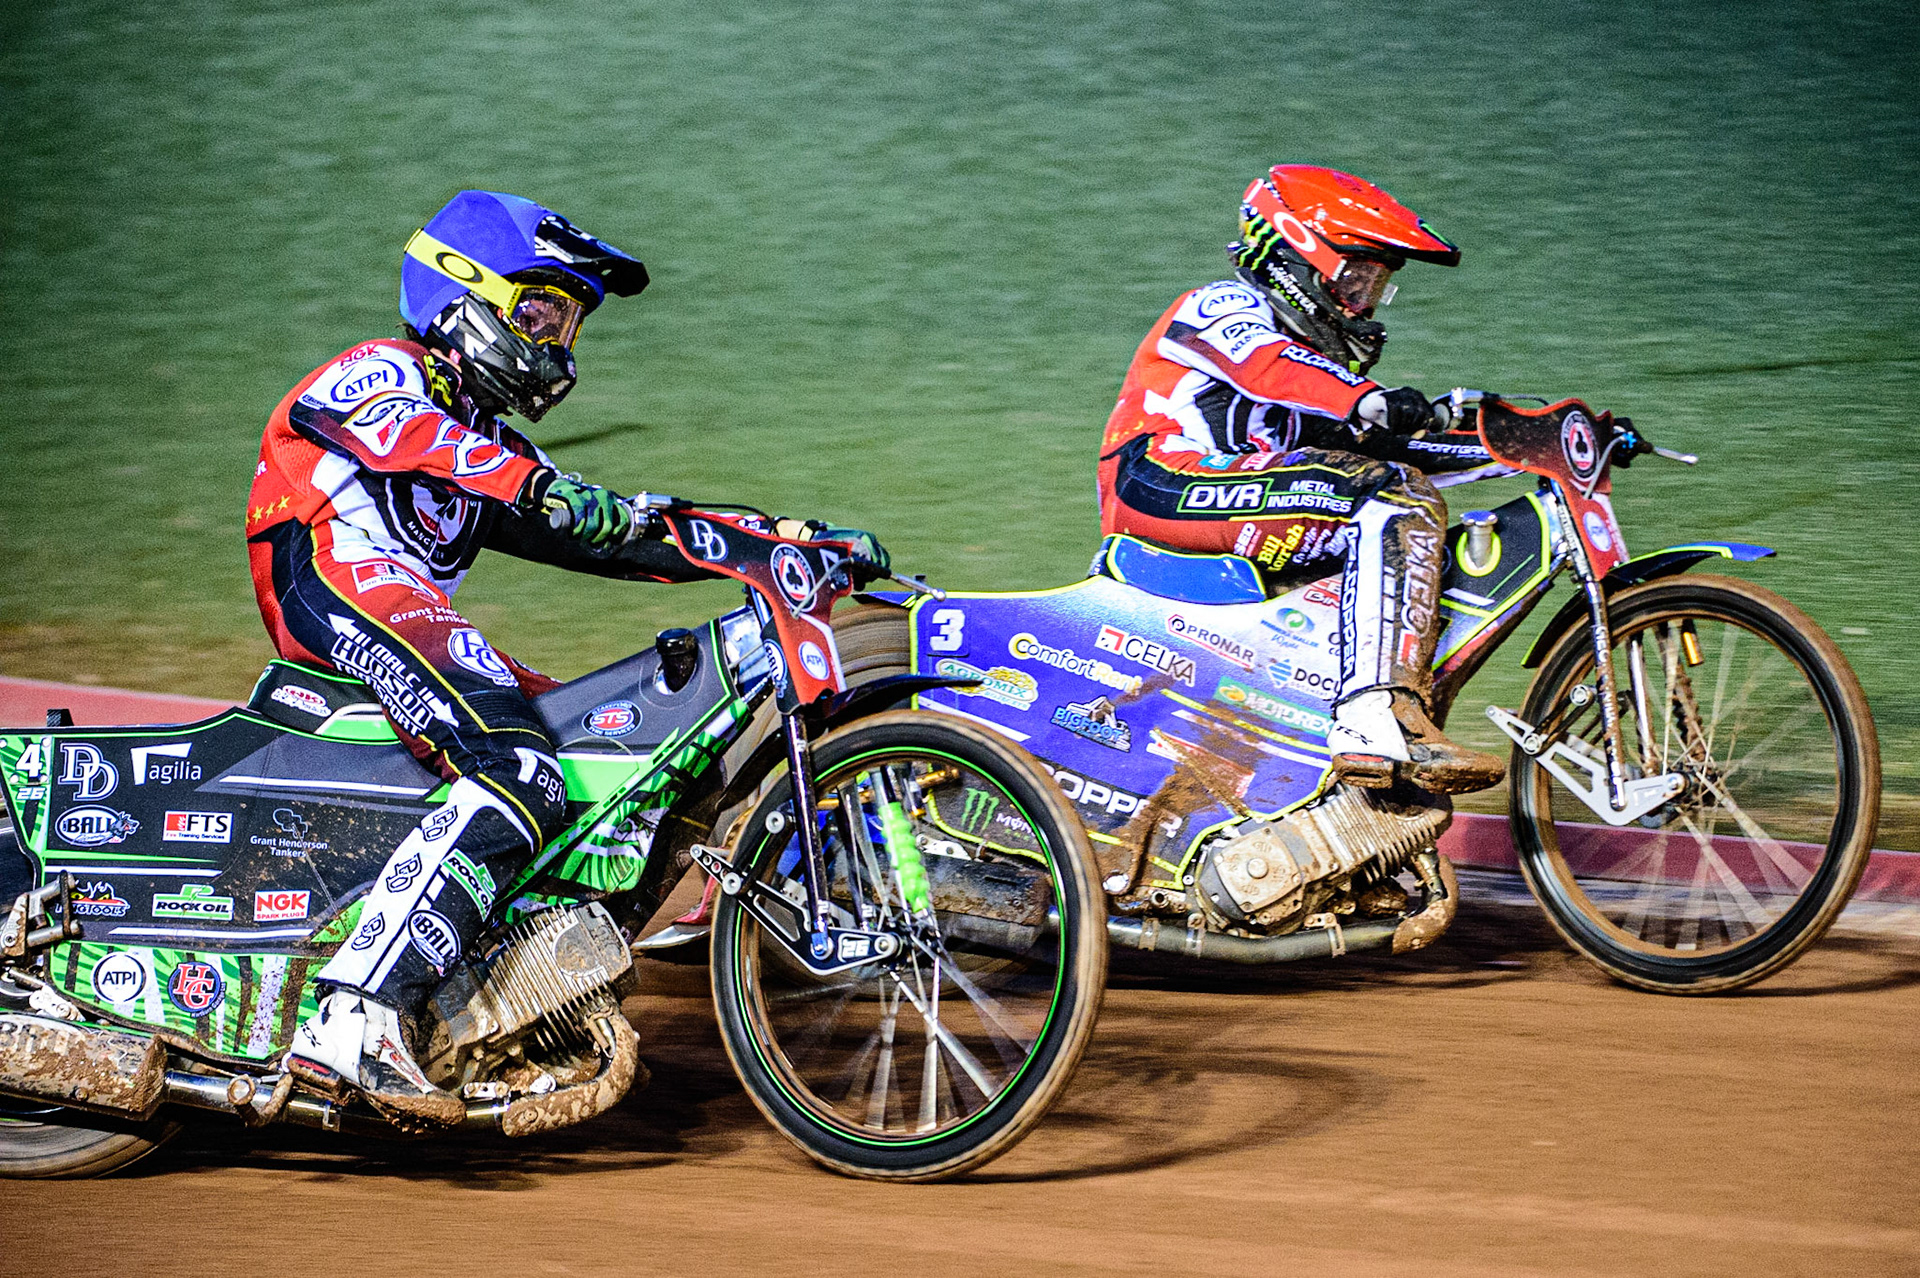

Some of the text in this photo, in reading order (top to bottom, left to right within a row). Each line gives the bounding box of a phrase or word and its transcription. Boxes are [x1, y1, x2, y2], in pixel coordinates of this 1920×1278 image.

[1207, 294, 1248, 310] ATPI
[345, 369, 388, 397] ATPI
[1186, 483, 1263, 508] DVR
[1289, 479, 1336, 496] METAL
[1257, 534, 1282, 565] Bill
[390, 607, 432, 624] Grant
[929, 608, 966, 651] 3
[1186, 625, 1254, 662] PRONAR
[1125, 637, 1197, 684] CELKA
[330, 633, 435, 730] HUDSON
[944, 663, 1028, 699] AGROMIX
[593, 711, 630, 724] STS
[1053, 706, 1124, 742] BIGFOOT
[1245, 692, 1335, 733] MOTOREX
[16, 744, 43, 778] 4
[58, 743, 119, 801] DD
[149, 761, 202, 784] agilia
[17, 787, 46, 800] 26
[186, 814, 228, 833] FTS
[250, 836, 328, 850] Grant Henderson
[270, 847, 307, 858] Tankers
[449, 856, 482, 897] ROCK
[155, 901, 230, 914] ROCK OIL
[256, 893, 307, 912] NGK
[281, 911, 306, 919] PLUGS
[842, 938, 870, 958] 26
[101, 971, 136, 985] ATPI
